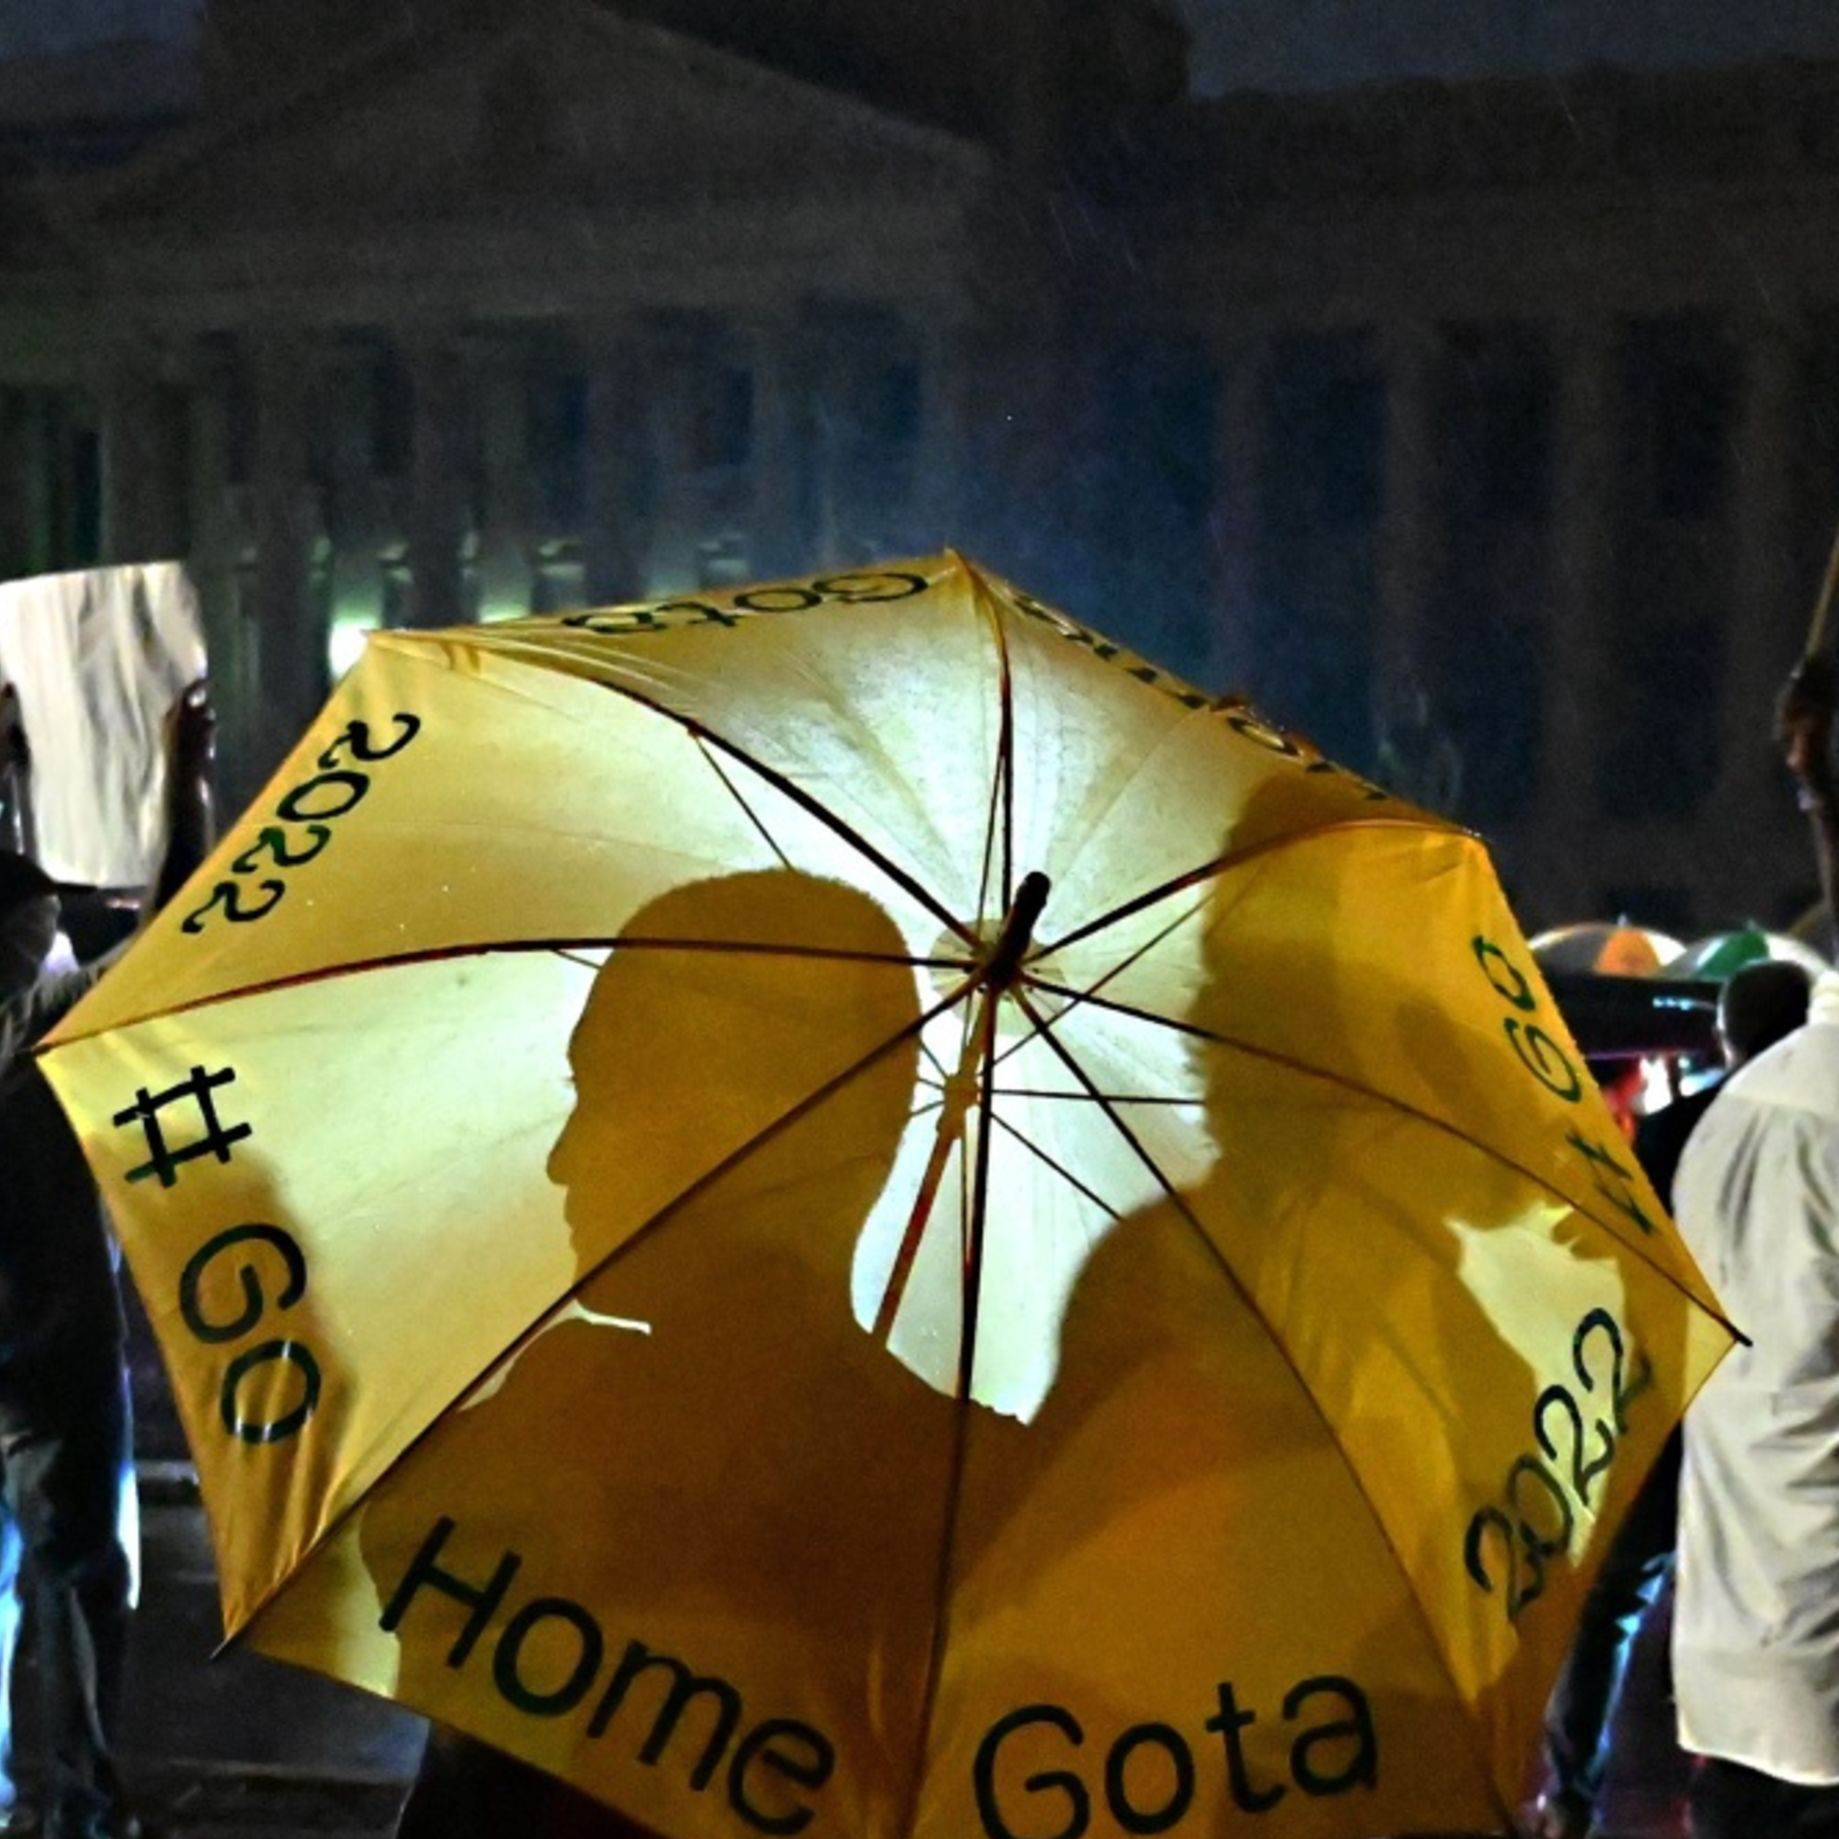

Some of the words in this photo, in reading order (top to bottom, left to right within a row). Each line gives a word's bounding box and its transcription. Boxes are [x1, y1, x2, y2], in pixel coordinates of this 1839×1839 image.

[180, 713, 421, 934] 2022
[379, 1516, 835, 1836] Home
[1465, 1307, 1654, 1626] 2022
